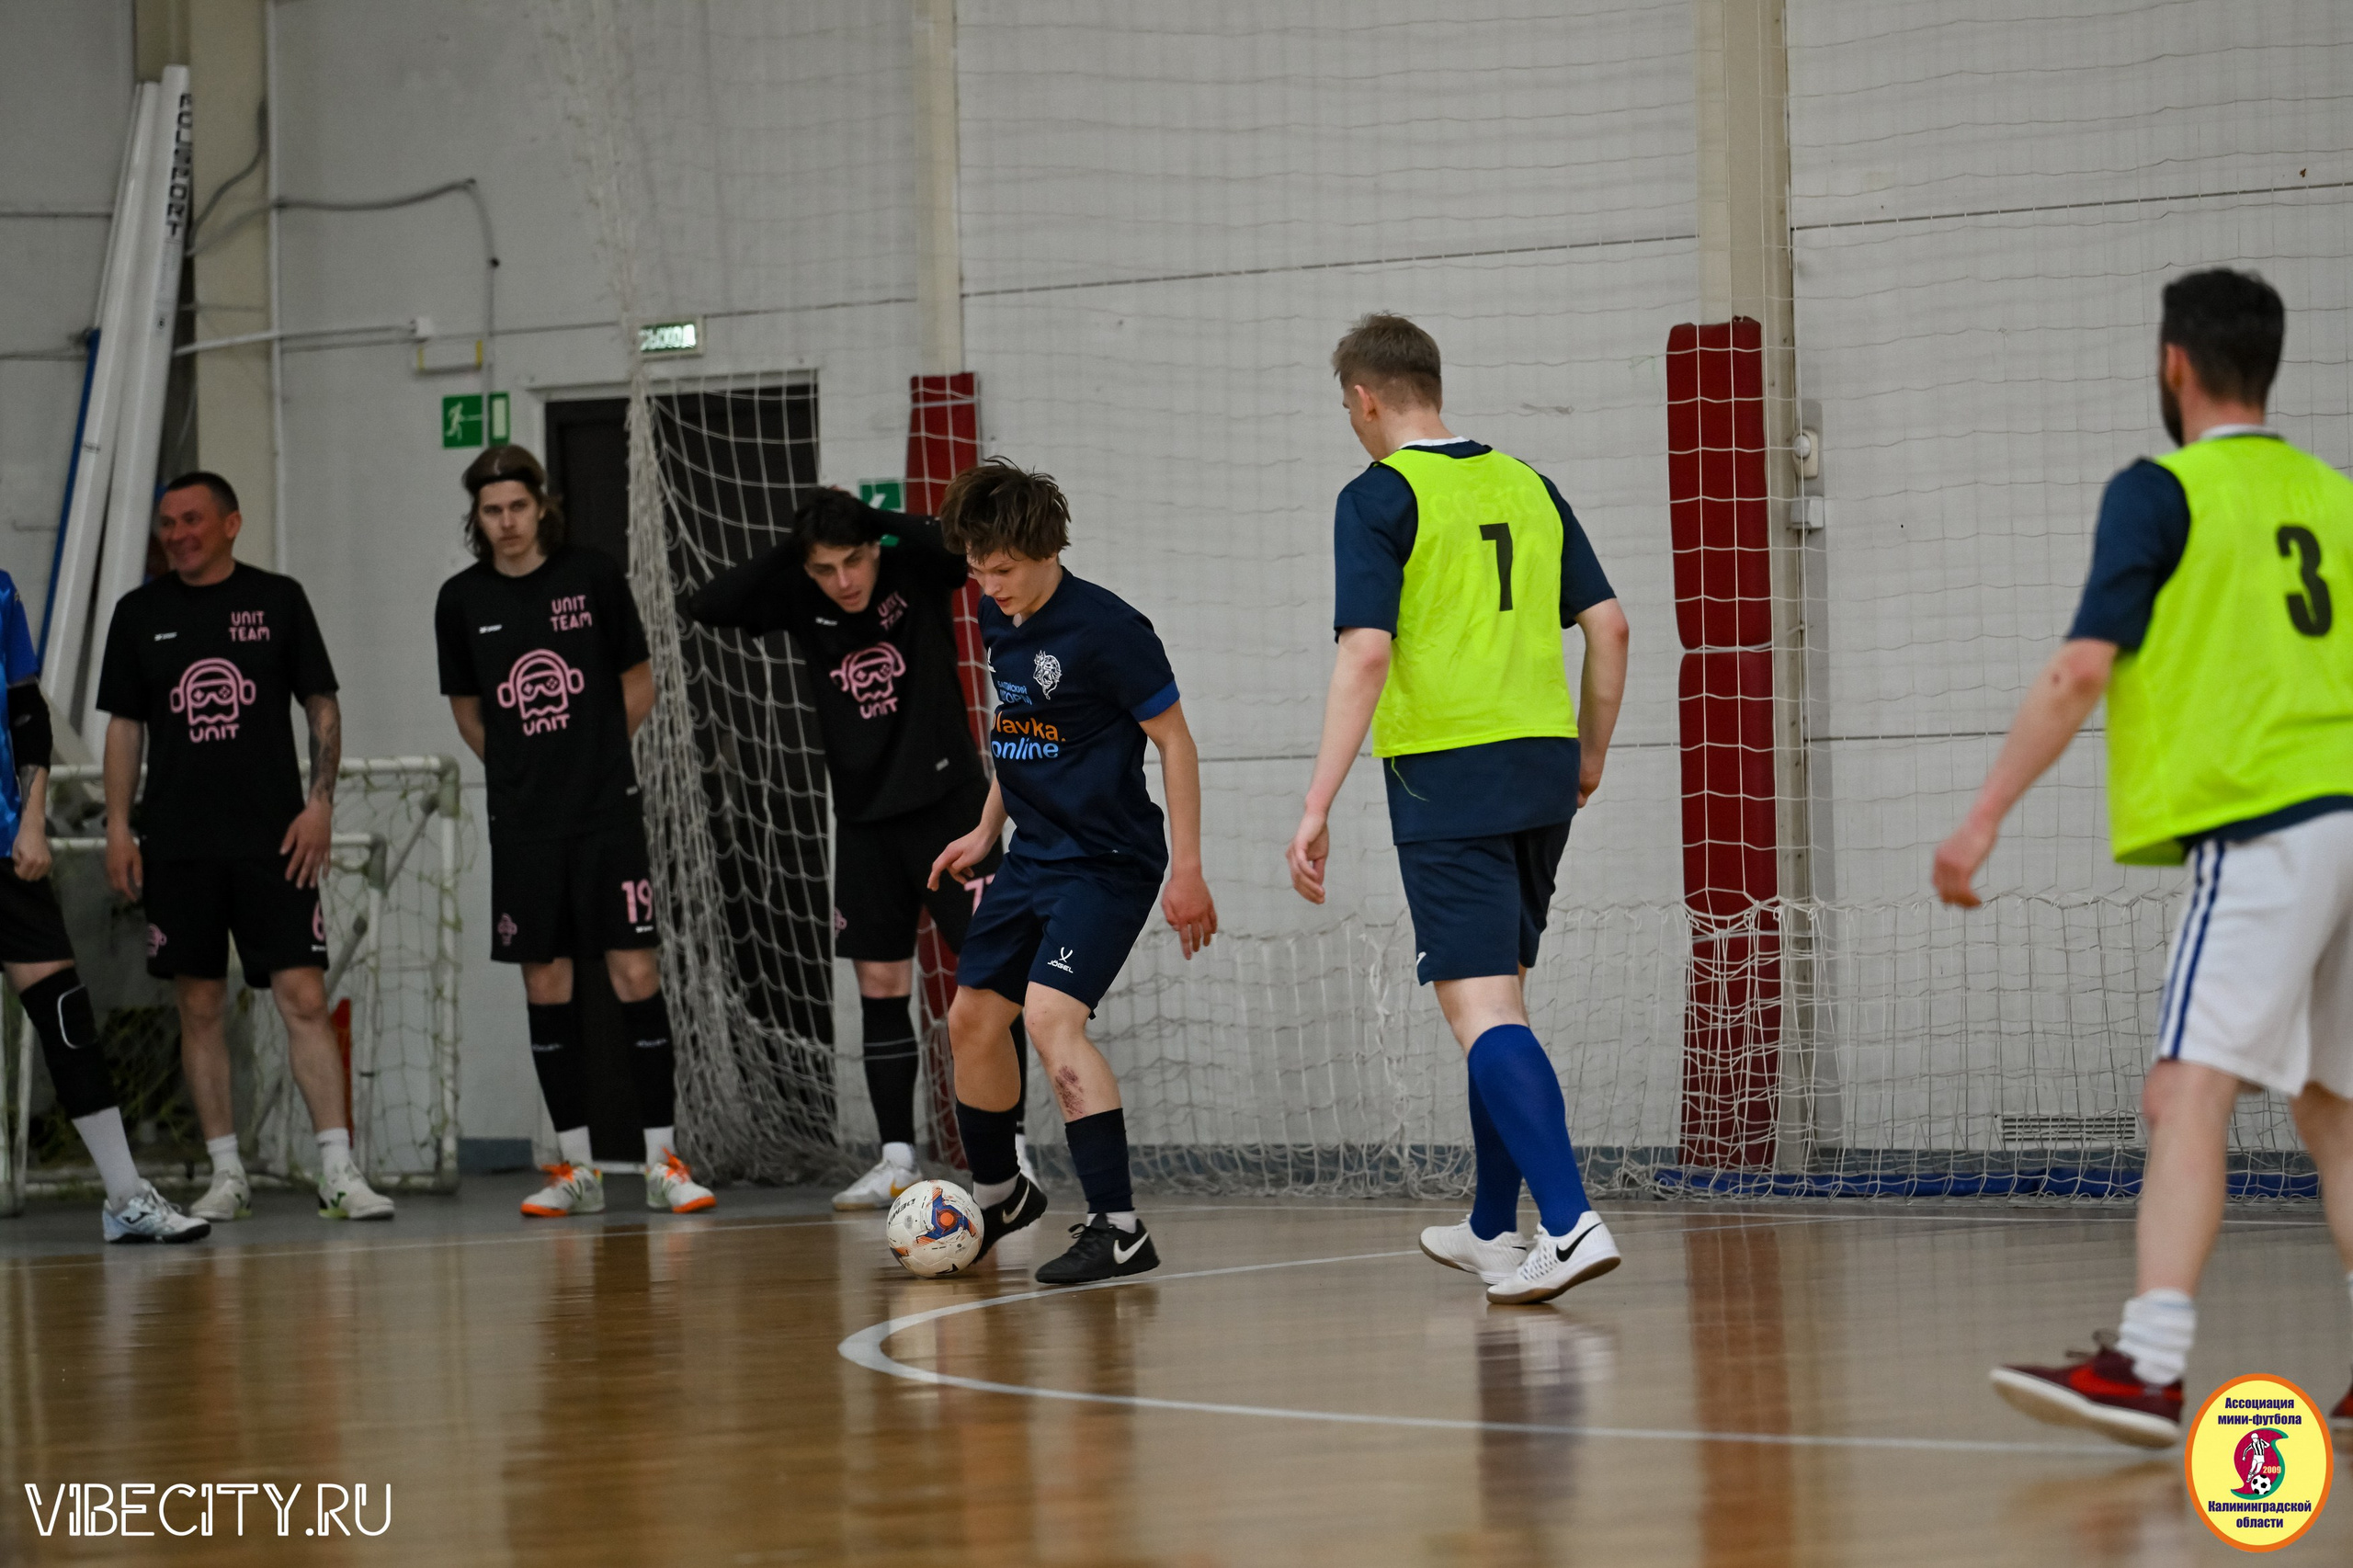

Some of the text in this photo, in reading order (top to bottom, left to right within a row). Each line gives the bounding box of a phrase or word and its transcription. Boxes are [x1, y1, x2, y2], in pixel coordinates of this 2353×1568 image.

[1479, 522, 1513, 612] 1
[2276, 524, 2332, 637] 3
[551, 595, 586, 614] UNIT
[231, 610, 265, 626] UNIT
[550, 611, 593, 632] TEAM
[229, 626, 270, 642] TEAM
[859, 697, 899, 720] UNIT
[189, 723, 240, 743] UNIT
[523, 713, 570, 736] UNIT
[992, 737, 1059, 761] online
[621, 878, 653, 924] 19
[964, 874, 995, 916] 7
